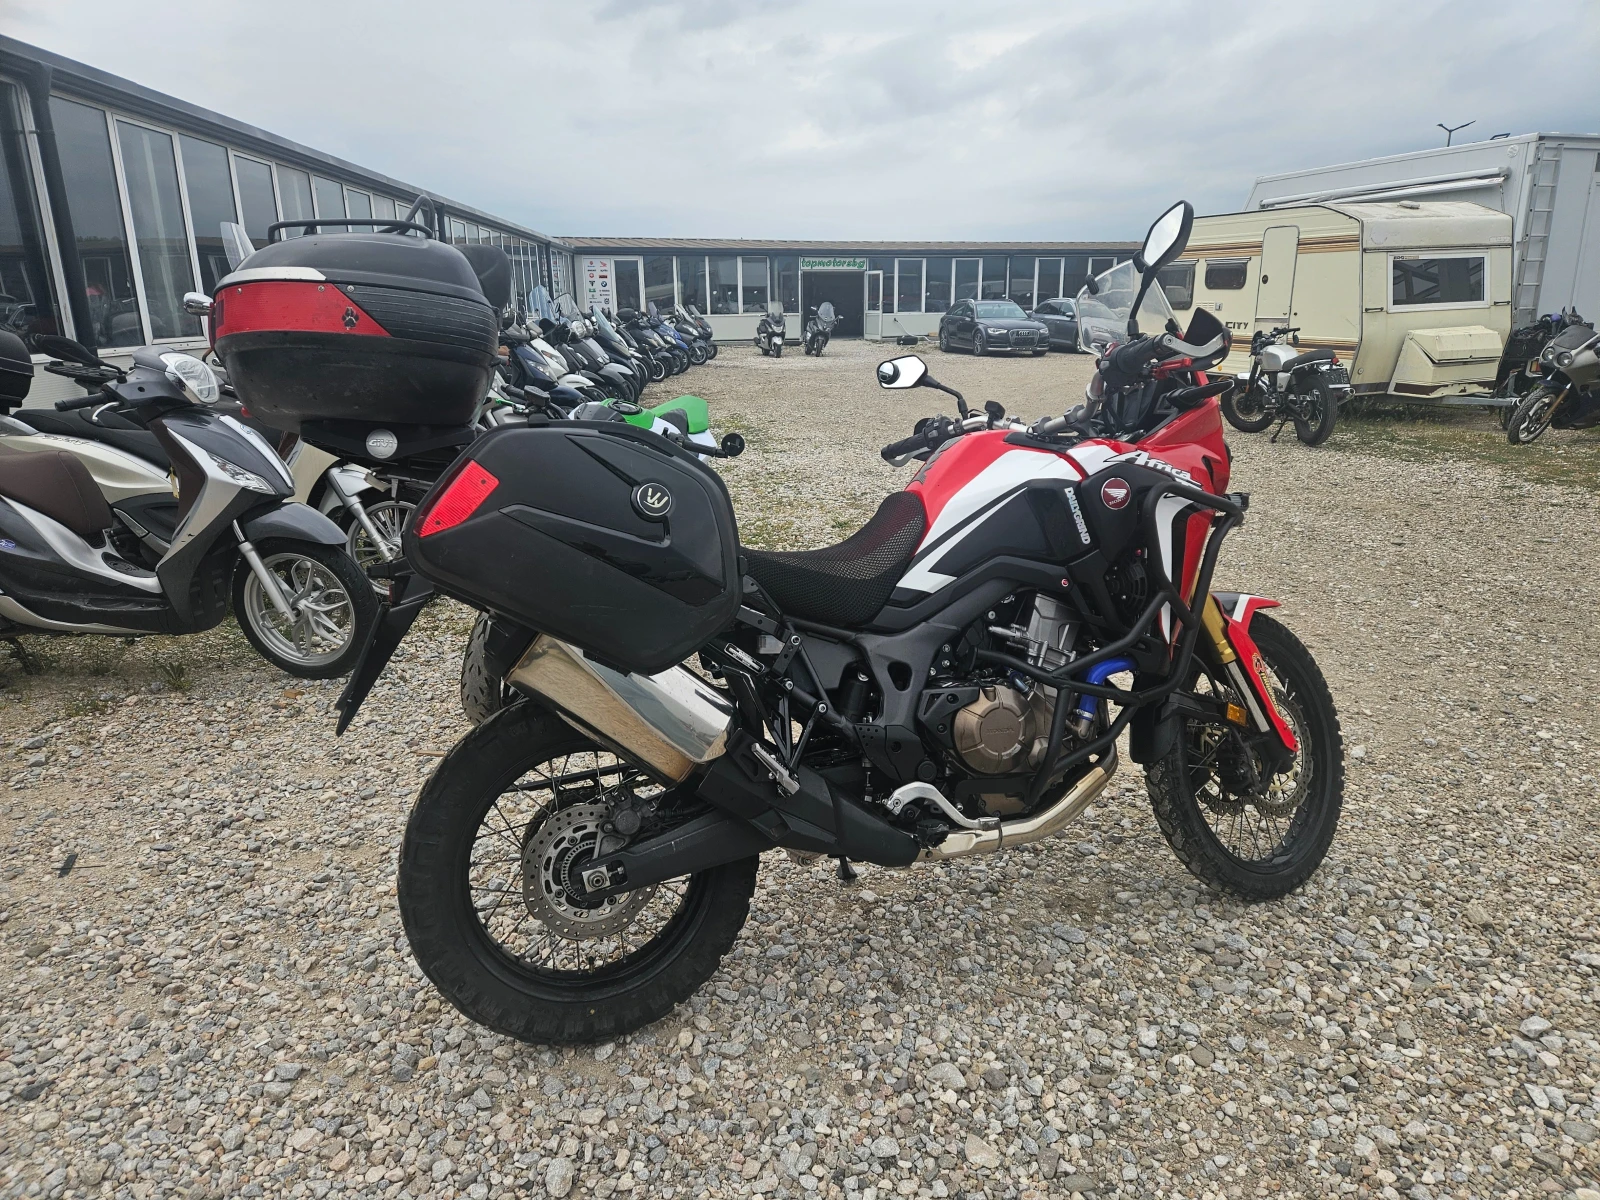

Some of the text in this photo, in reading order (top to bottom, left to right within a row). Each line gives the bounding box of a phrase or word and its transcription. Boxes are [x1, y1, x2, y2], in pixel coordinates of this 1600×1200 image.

[1225, 321, 1249, 330] CITY
[368, 438, 394, 447] GIVI
[1103, 449, 1192, 481] Africa
